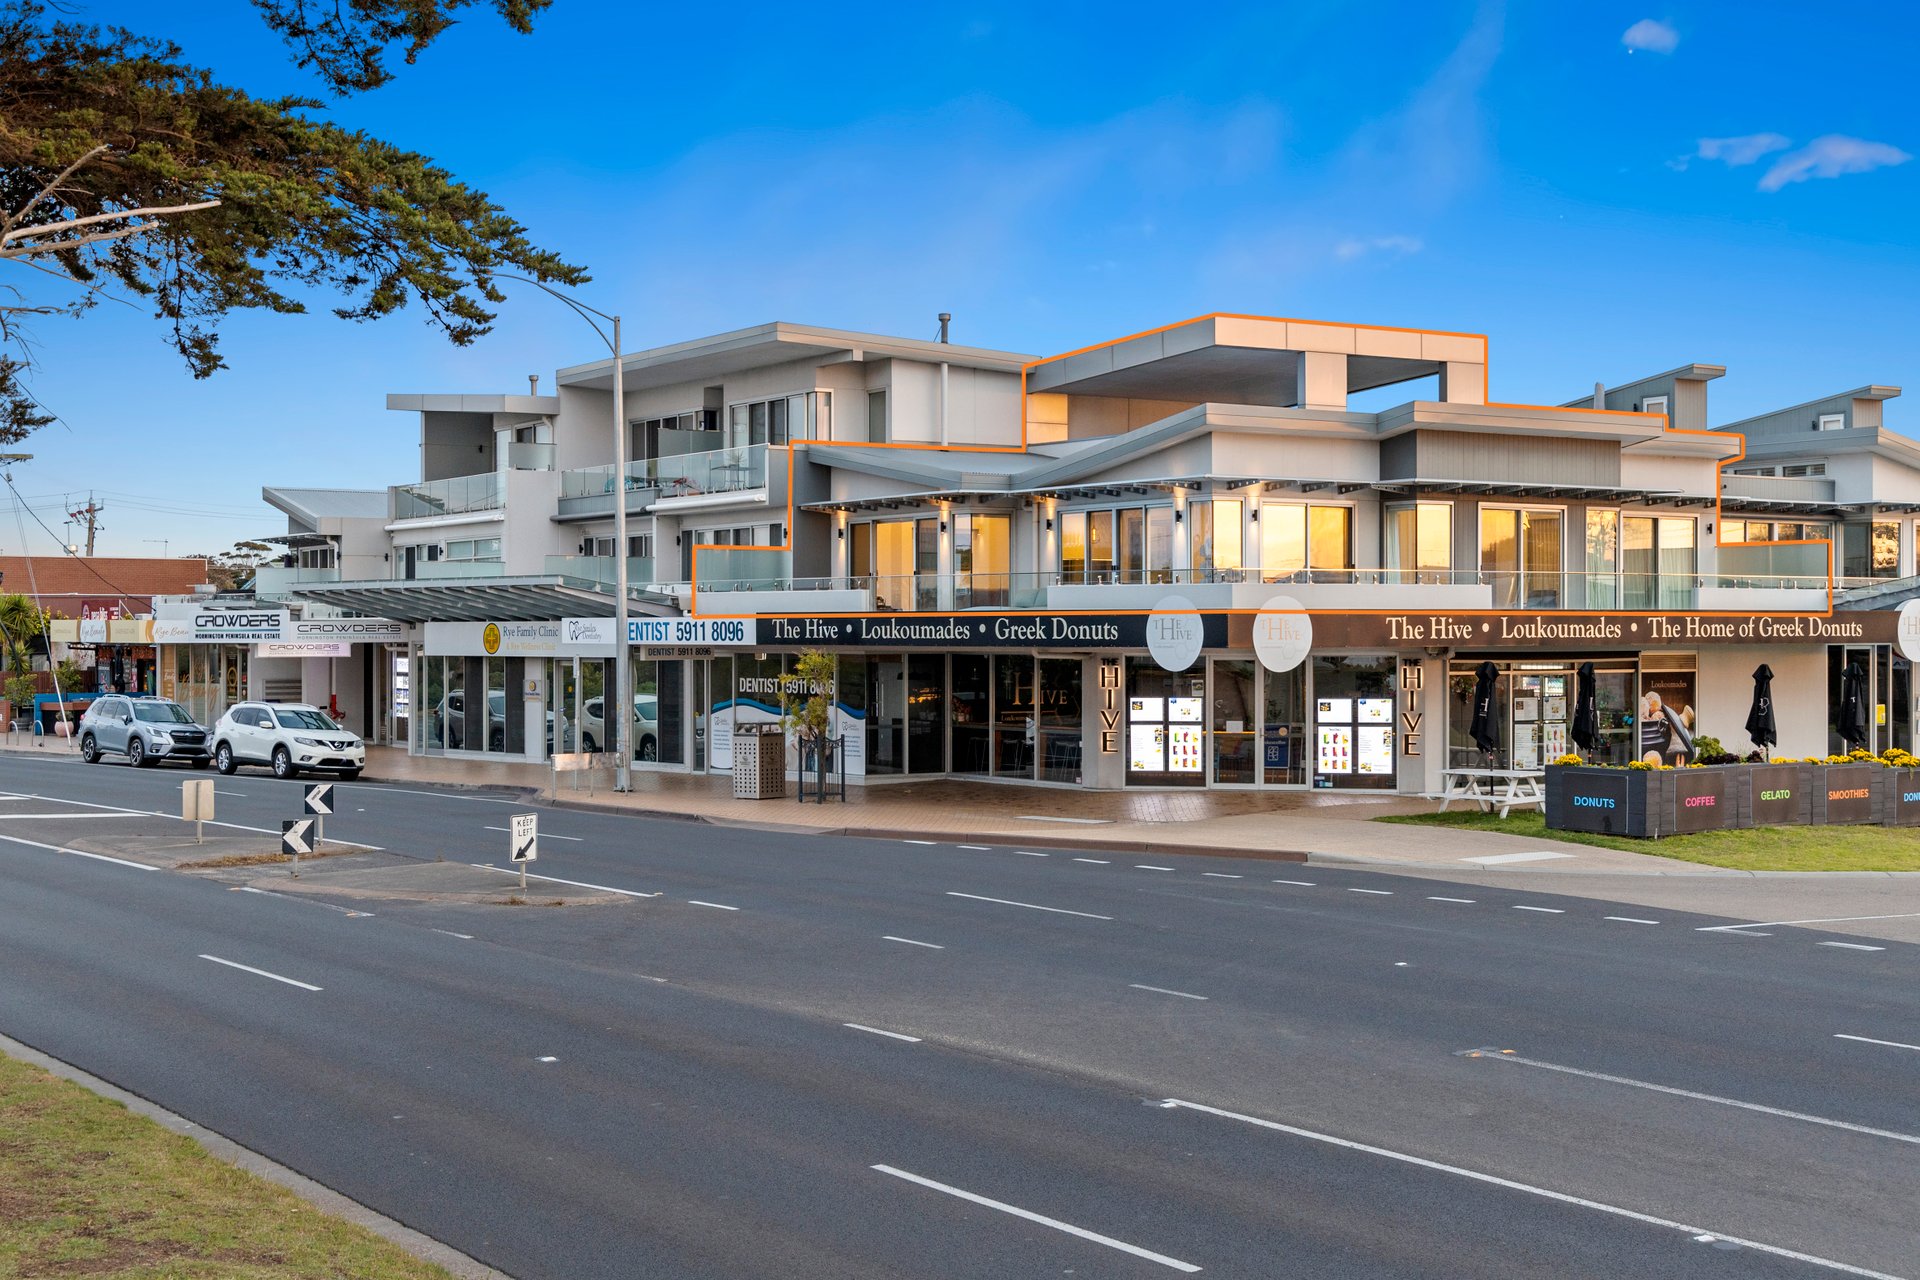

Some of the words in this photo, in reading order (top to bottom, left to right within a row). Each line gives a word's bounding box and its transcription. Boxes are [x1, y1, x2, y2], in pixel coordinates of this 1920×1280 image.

[195, 614, 280, 627] CROWDERS
[154, 626, 169, 640] Rye
[170, 626, 189, 637] Beau
[297, 624, 402, 632] CROWDERS
[504, 625, 516, 640] Rye
[517, 625, 537, 639] Family
[539, 625, 558, 637] Clinic
[628, 621, 670, 641] ENTIST
[676, 621, 707, 642] 5911
[711, 621, 744, 641] 8096
[772, 618, 800, 639] The
[804, 618, 838, 639] Hive
[860, 618, 970, 639] Loukoumades
[995, 617, 1047, 640] Greek
[1051, 617, 1118, 640] Donuts
[1386, 617, 1424, 640] The
[1430, 617, 1472, 640] Hive
[1500, 616, 1621, 639] Loukoumades
[1648, 617, 1680, 638] The
[1686, 617, 1735, 638] Home
[1739, 616, 1755, 638] of
[1759, 616, 1804, 638] Greek
[1808, 617, 1863, 638] Donuts
[582, 632, 602, 642] Dentistry
[647, 647, 675, 656] DENTIST
[677, 647, 693, 656] 5911
[695, 647, 711, 656] 8096
[1101, 658, 1119, 666] THE
[1403, 658, 1422, 666] THE
[739, 677, 779, 694] DENTIST
[786, 679, 807, 694] 5911
[809, 679, 834, 695] 86
[1651, 680, 1688, 688] Loukoumades
[1100, 666, 1120, 753] HIVE
[1402, 666, 1423, 756] HIVE
[1760, 789, 1791, 801] GELATO
[1828, 788, 1869, 800] SMOOTHIES
[1574, 795, 1615, 809] DONUTS
[1685, 795, 1716, 808] COFFEE
[517, 818, 534, 827] KEEP
[518, 827, 533, 837] LEFT
